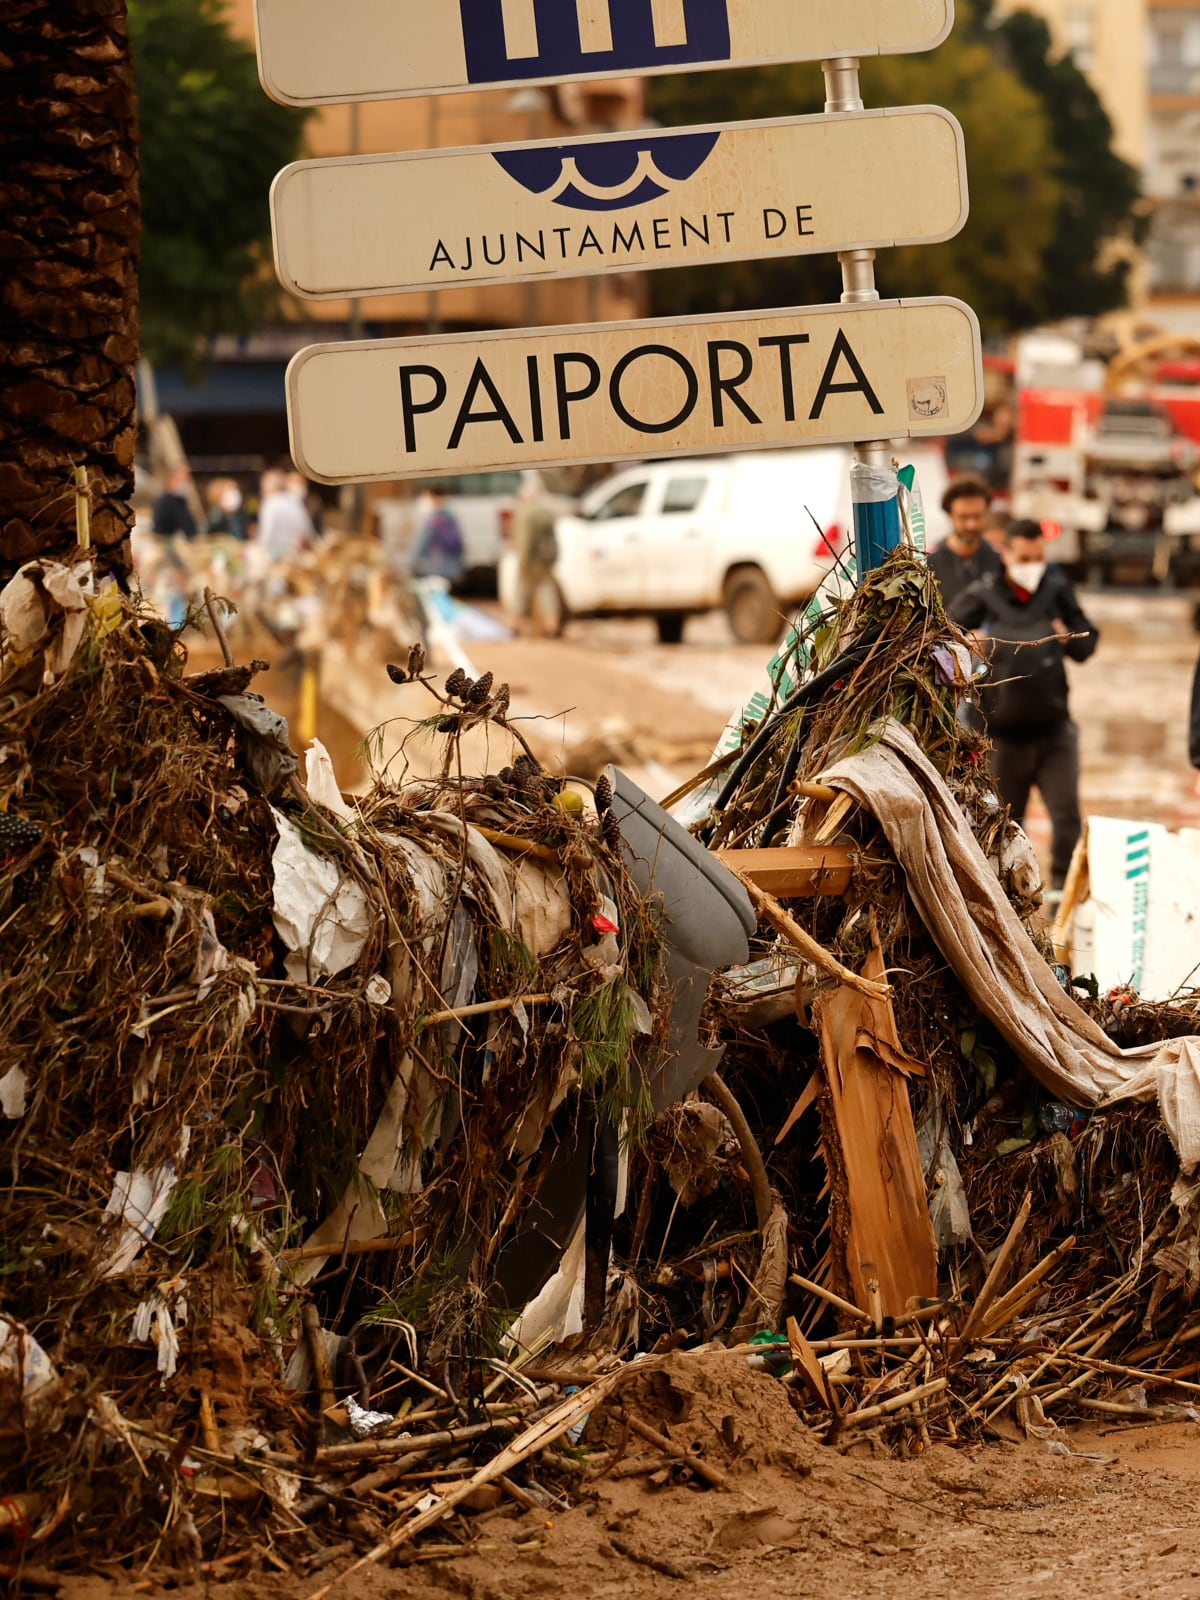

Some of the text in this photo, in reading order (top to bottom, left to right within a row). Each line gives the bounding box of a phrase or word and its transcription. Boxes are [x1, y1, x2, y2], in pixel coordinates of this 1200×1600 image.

[429, 204, 815, 272] AJUNTAMENT DE
[399, 328, 884, 453] PAIPORTA
